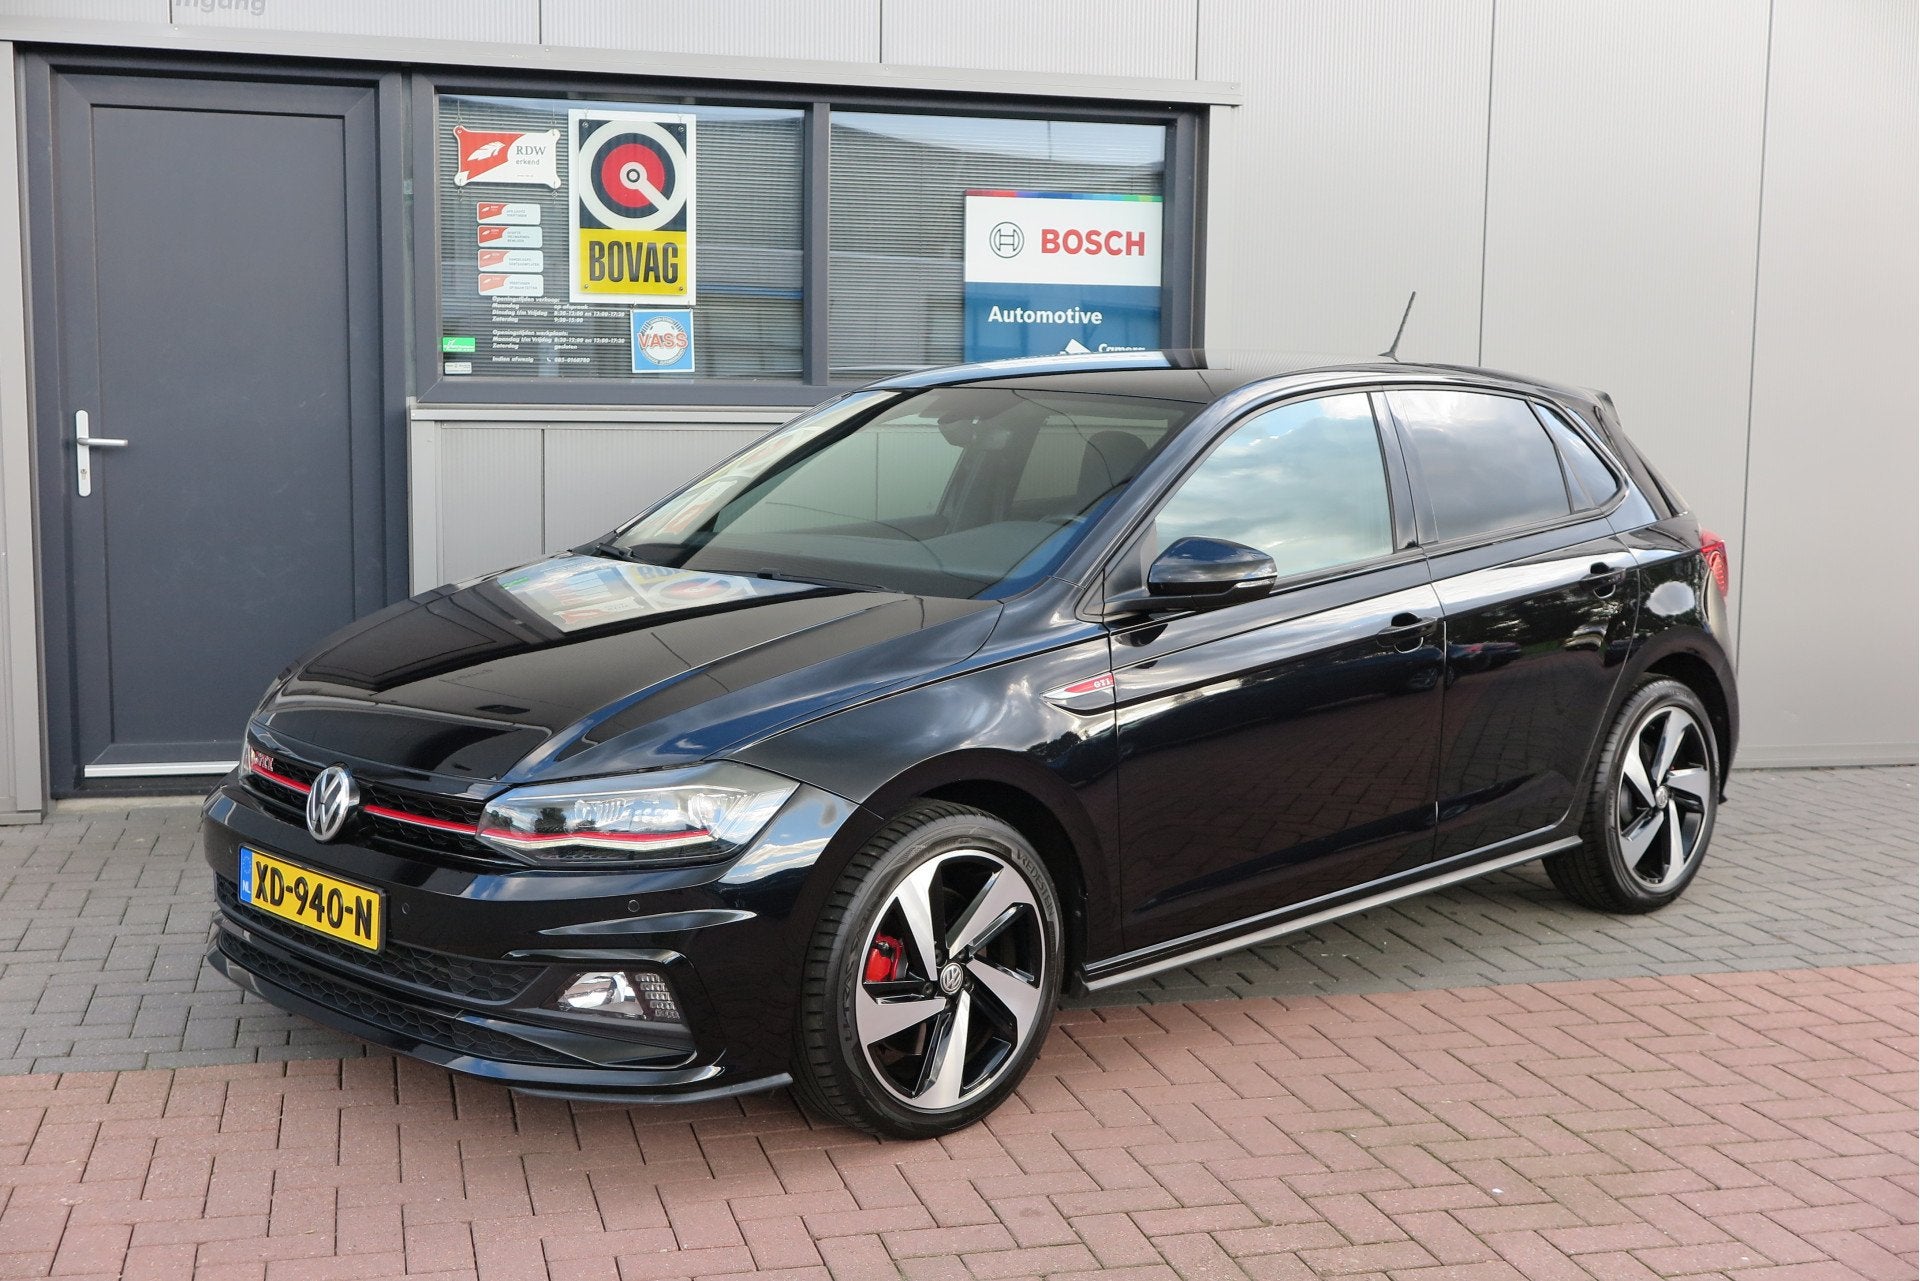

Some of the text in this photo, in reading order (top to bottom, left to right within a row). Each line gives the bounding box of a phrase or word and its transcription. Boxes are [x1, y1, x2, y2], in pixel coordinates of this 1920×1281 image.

[515, 145, 547, 156] RDW
[1041, 228, 1146, 256] BOSCH
[588, 240, 679, 284] BOVAG
[988, 306, 1102, 324] Automotive
[637, 332, 688, 349] VASS
[1093, 678, 1111, 689] GTI
[242, 879, 252, 895] NL
[1016, 848, 1055, 918] VREDESTEIN
[254, 860, 373, 941] XD-940-N
